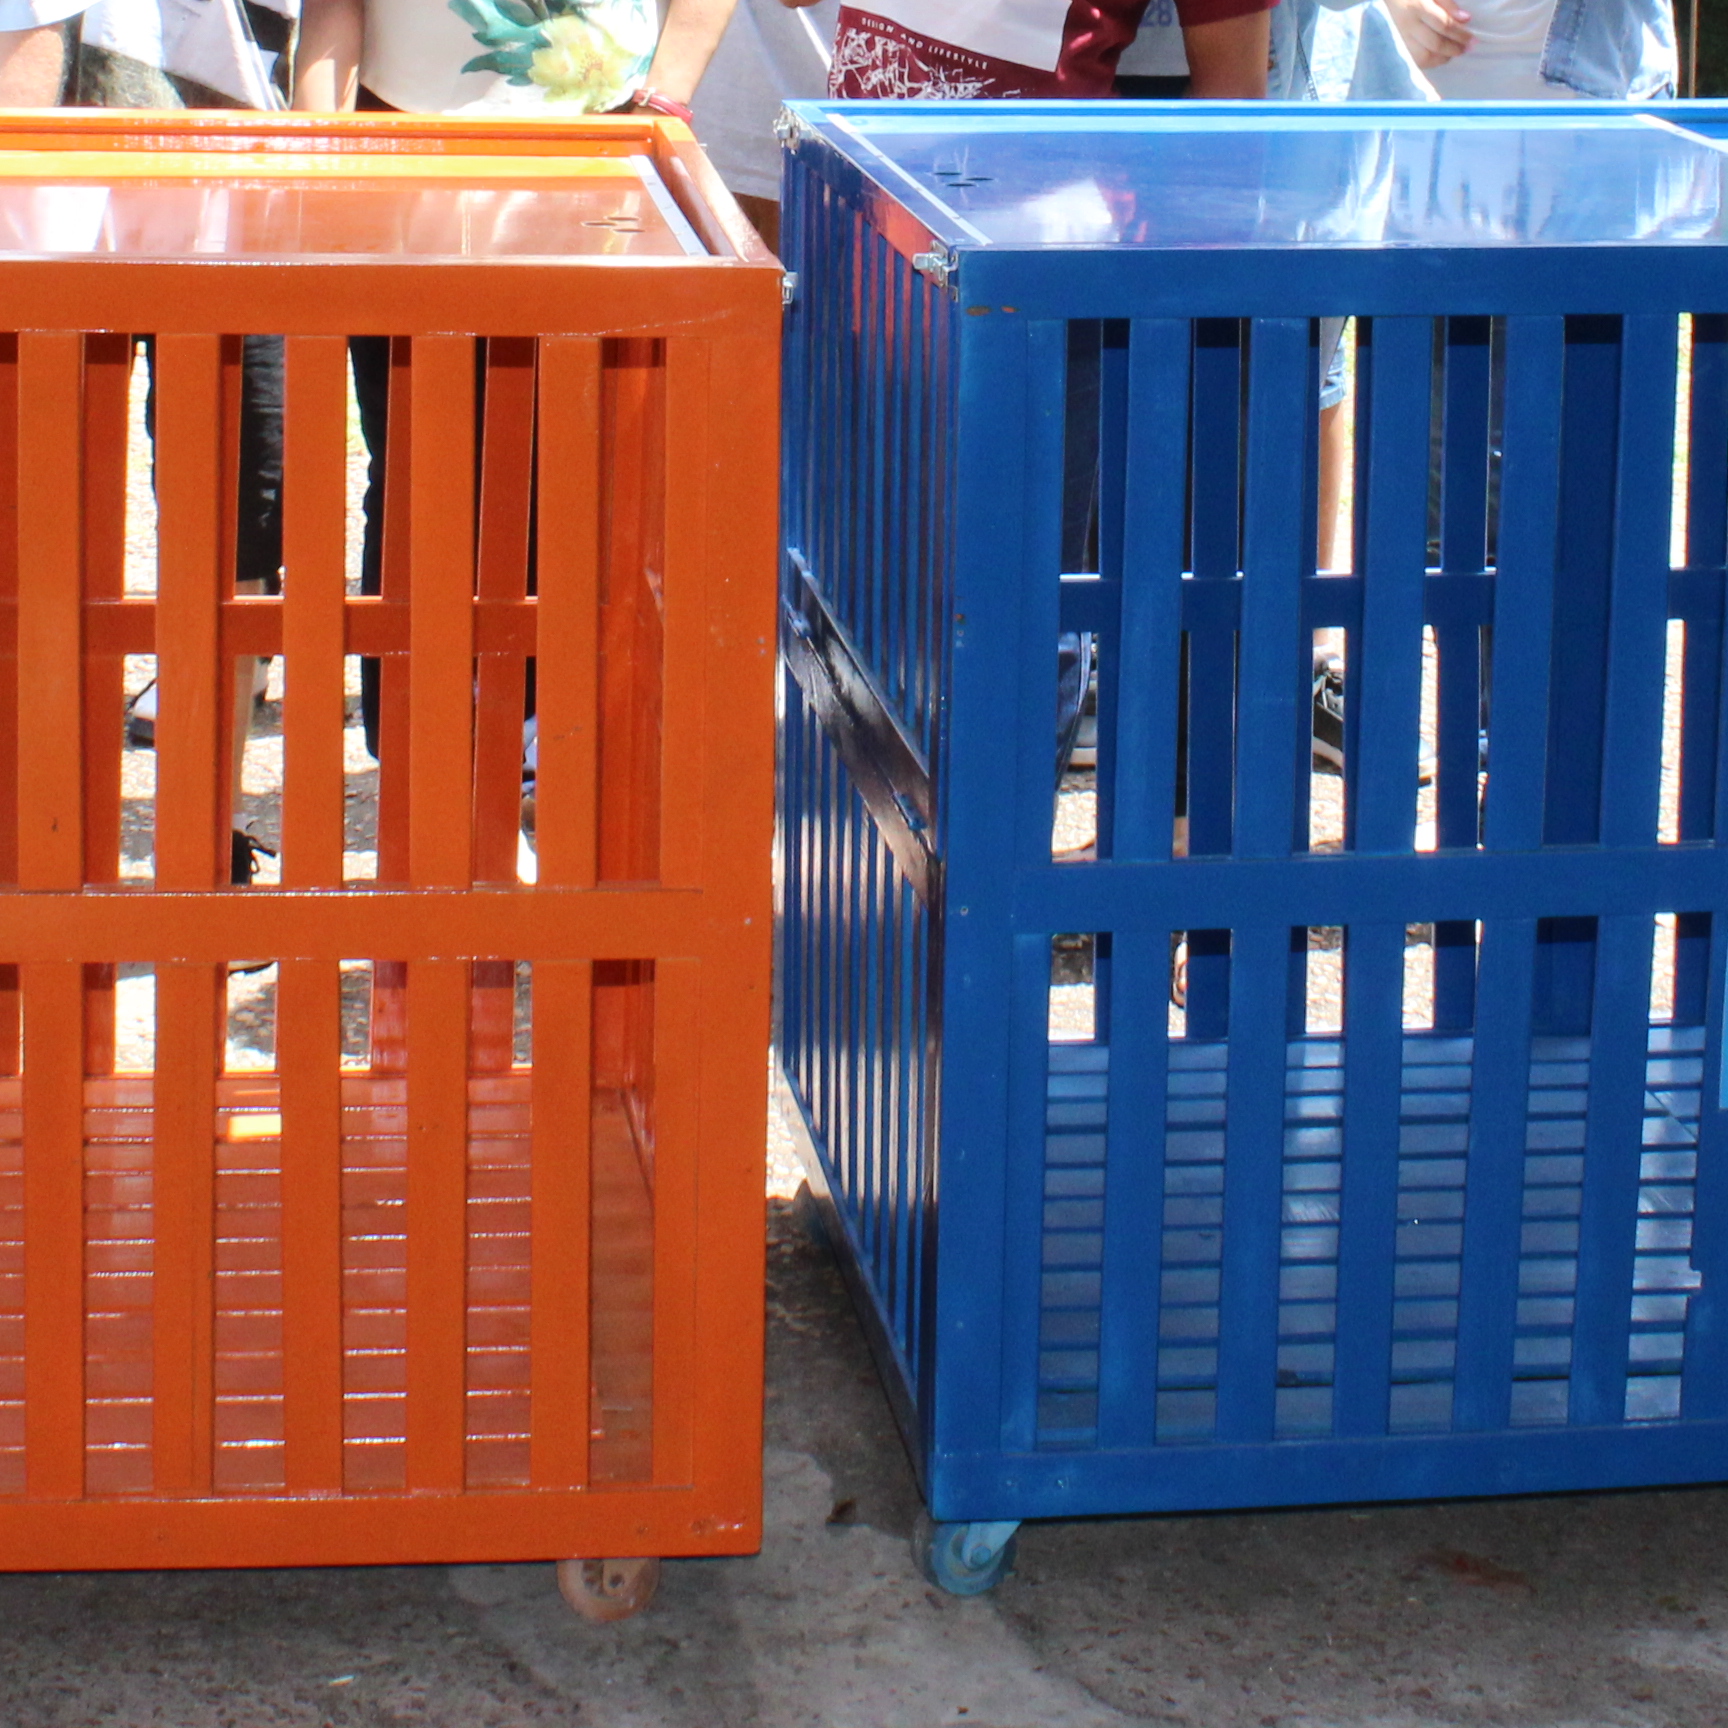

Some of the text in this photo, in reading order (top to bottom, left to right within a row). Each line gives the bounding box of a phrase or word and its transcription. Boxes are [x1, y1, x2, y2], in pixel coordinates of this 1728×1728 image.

[861, 16, 989, 71] DESIGN AND LIFESTYLE
